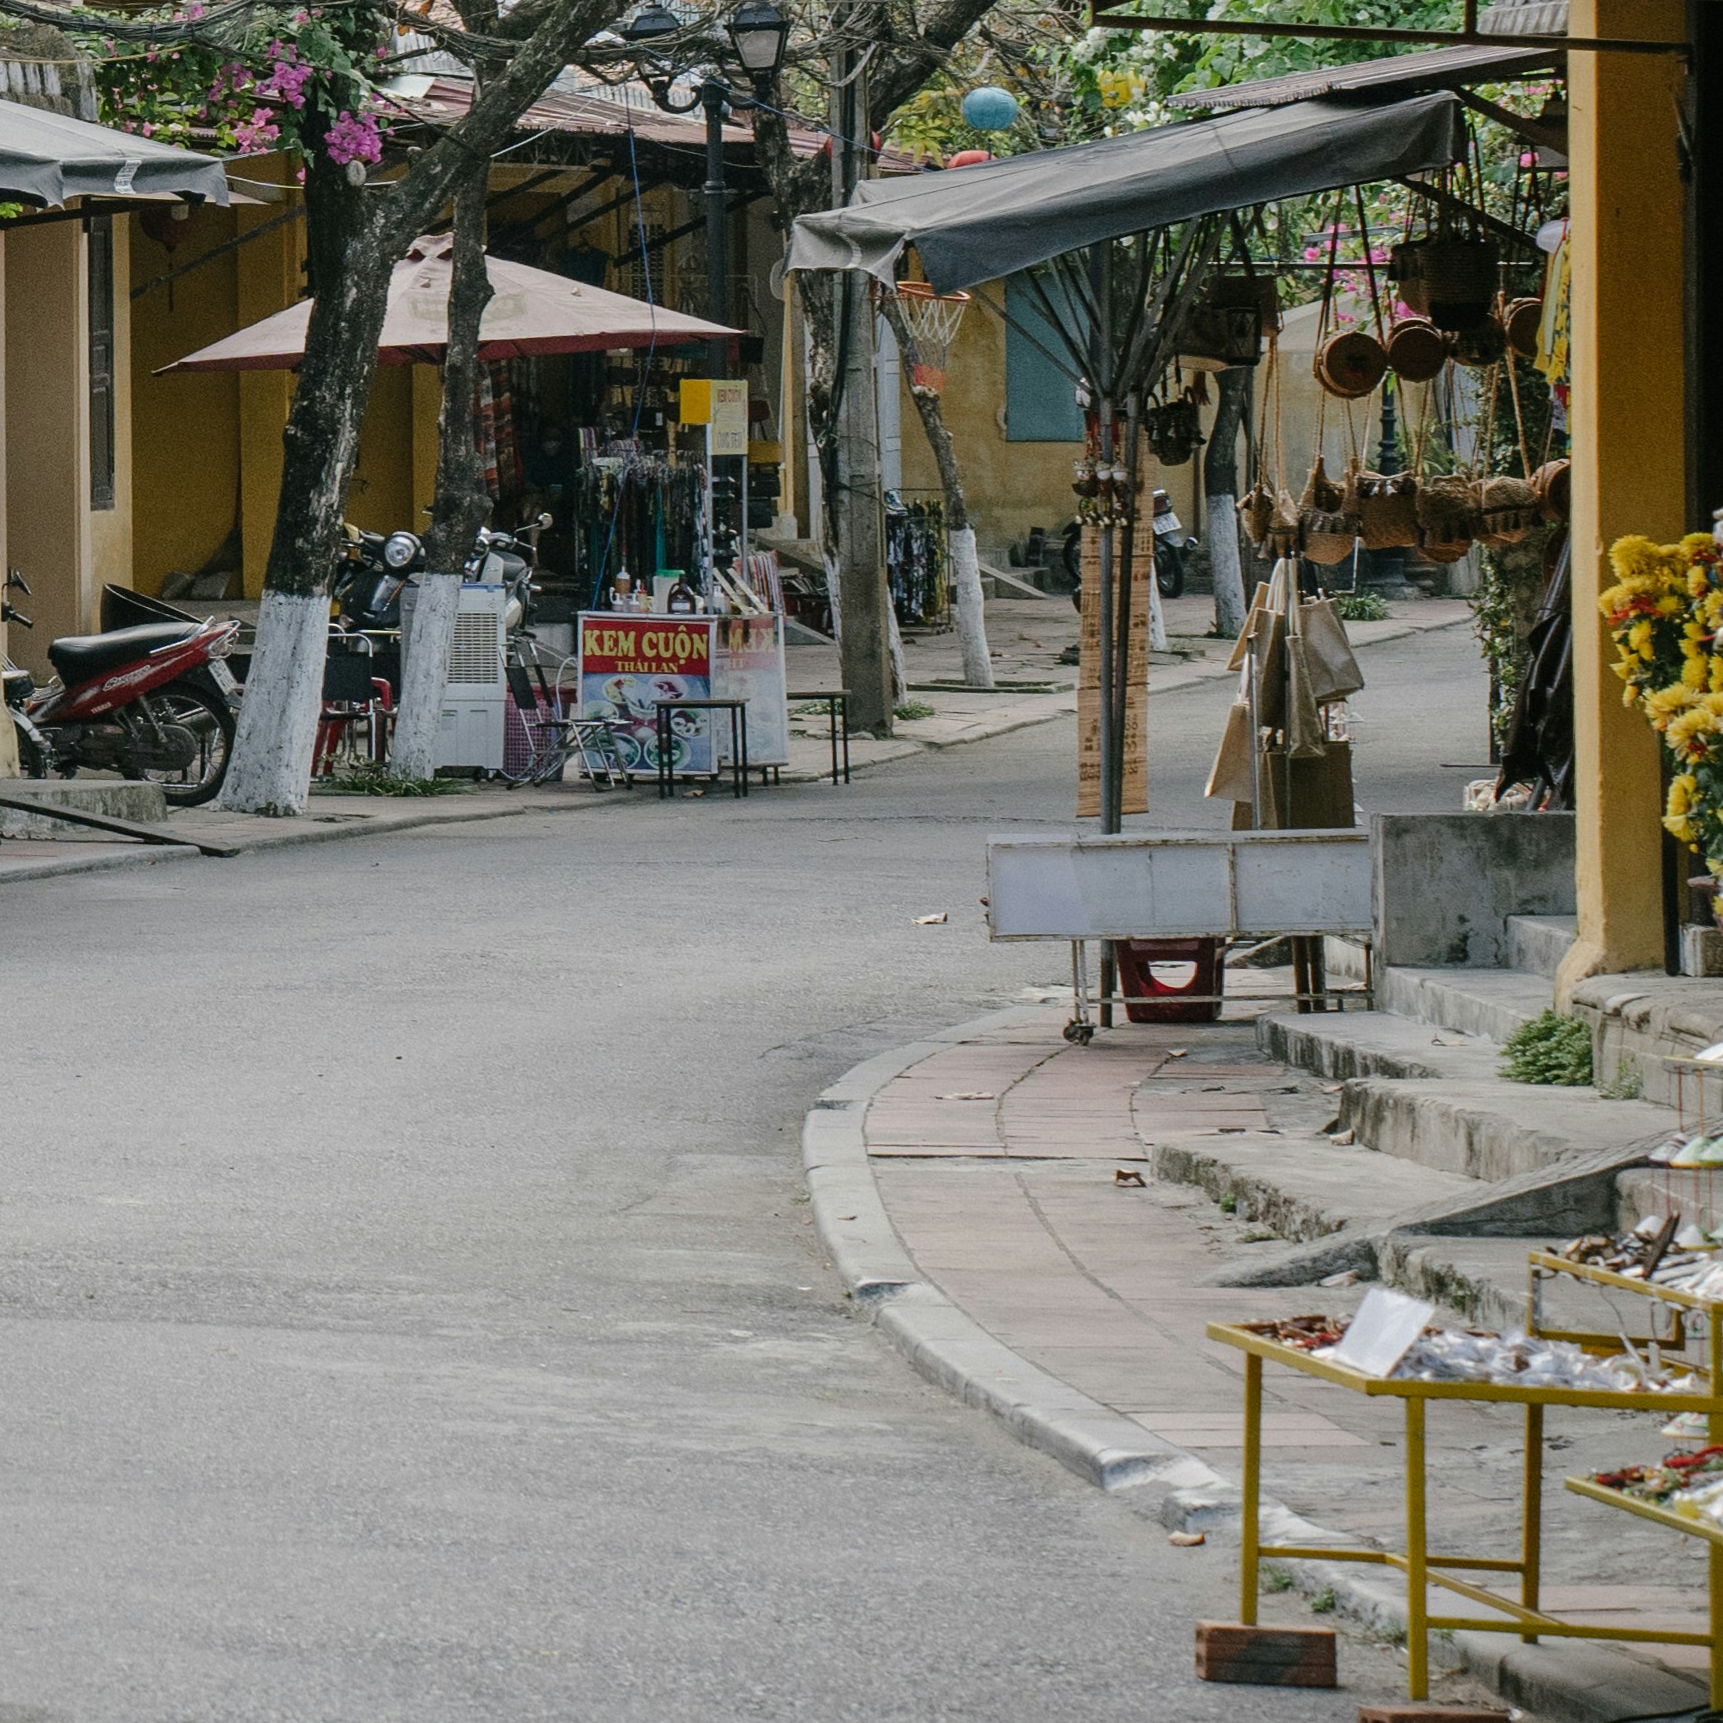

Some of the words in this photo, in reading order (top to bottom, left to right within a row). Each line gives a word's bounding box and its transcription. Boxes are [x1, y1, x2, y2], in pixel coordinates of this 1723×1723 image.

[584, 629, 636, 657] KEM
[641, 625, 709, 665] CUỘN
[651, 662, 679, 674] LAN
